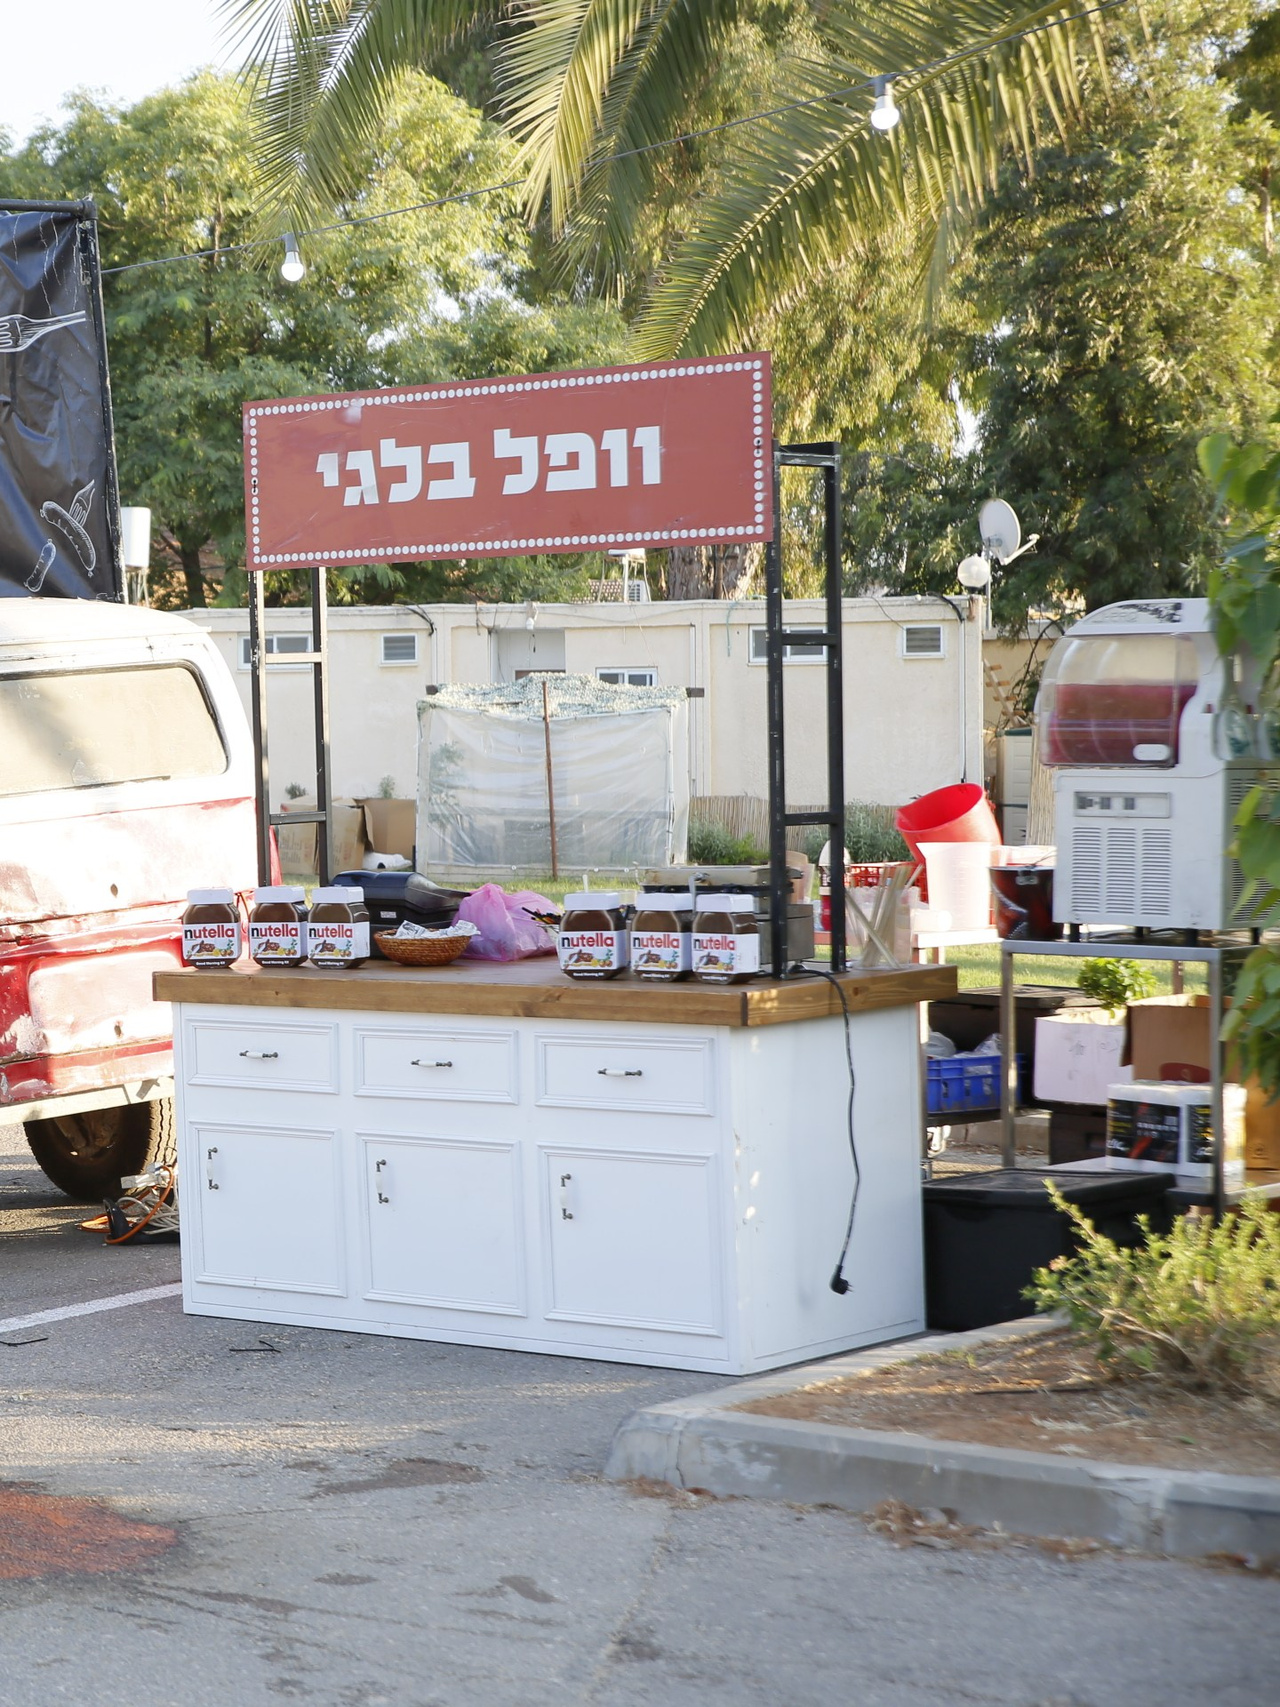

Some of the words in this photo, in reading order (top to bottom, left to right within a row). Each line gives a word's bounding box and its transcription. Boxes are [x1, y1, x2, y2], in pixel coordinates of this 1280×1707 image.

[492, 425, 662, 496] וופל
[316, 438, 477, 507] בלגי
[184, 924, 235, 939] nutella
[251, 923, 299, 938] nutella
[308, 924, 353, 939] nutella
[561, 932, 615, 948] nutella
[632, 933, 680, 949] nutella
[693, 935, 736, 951] nutella
